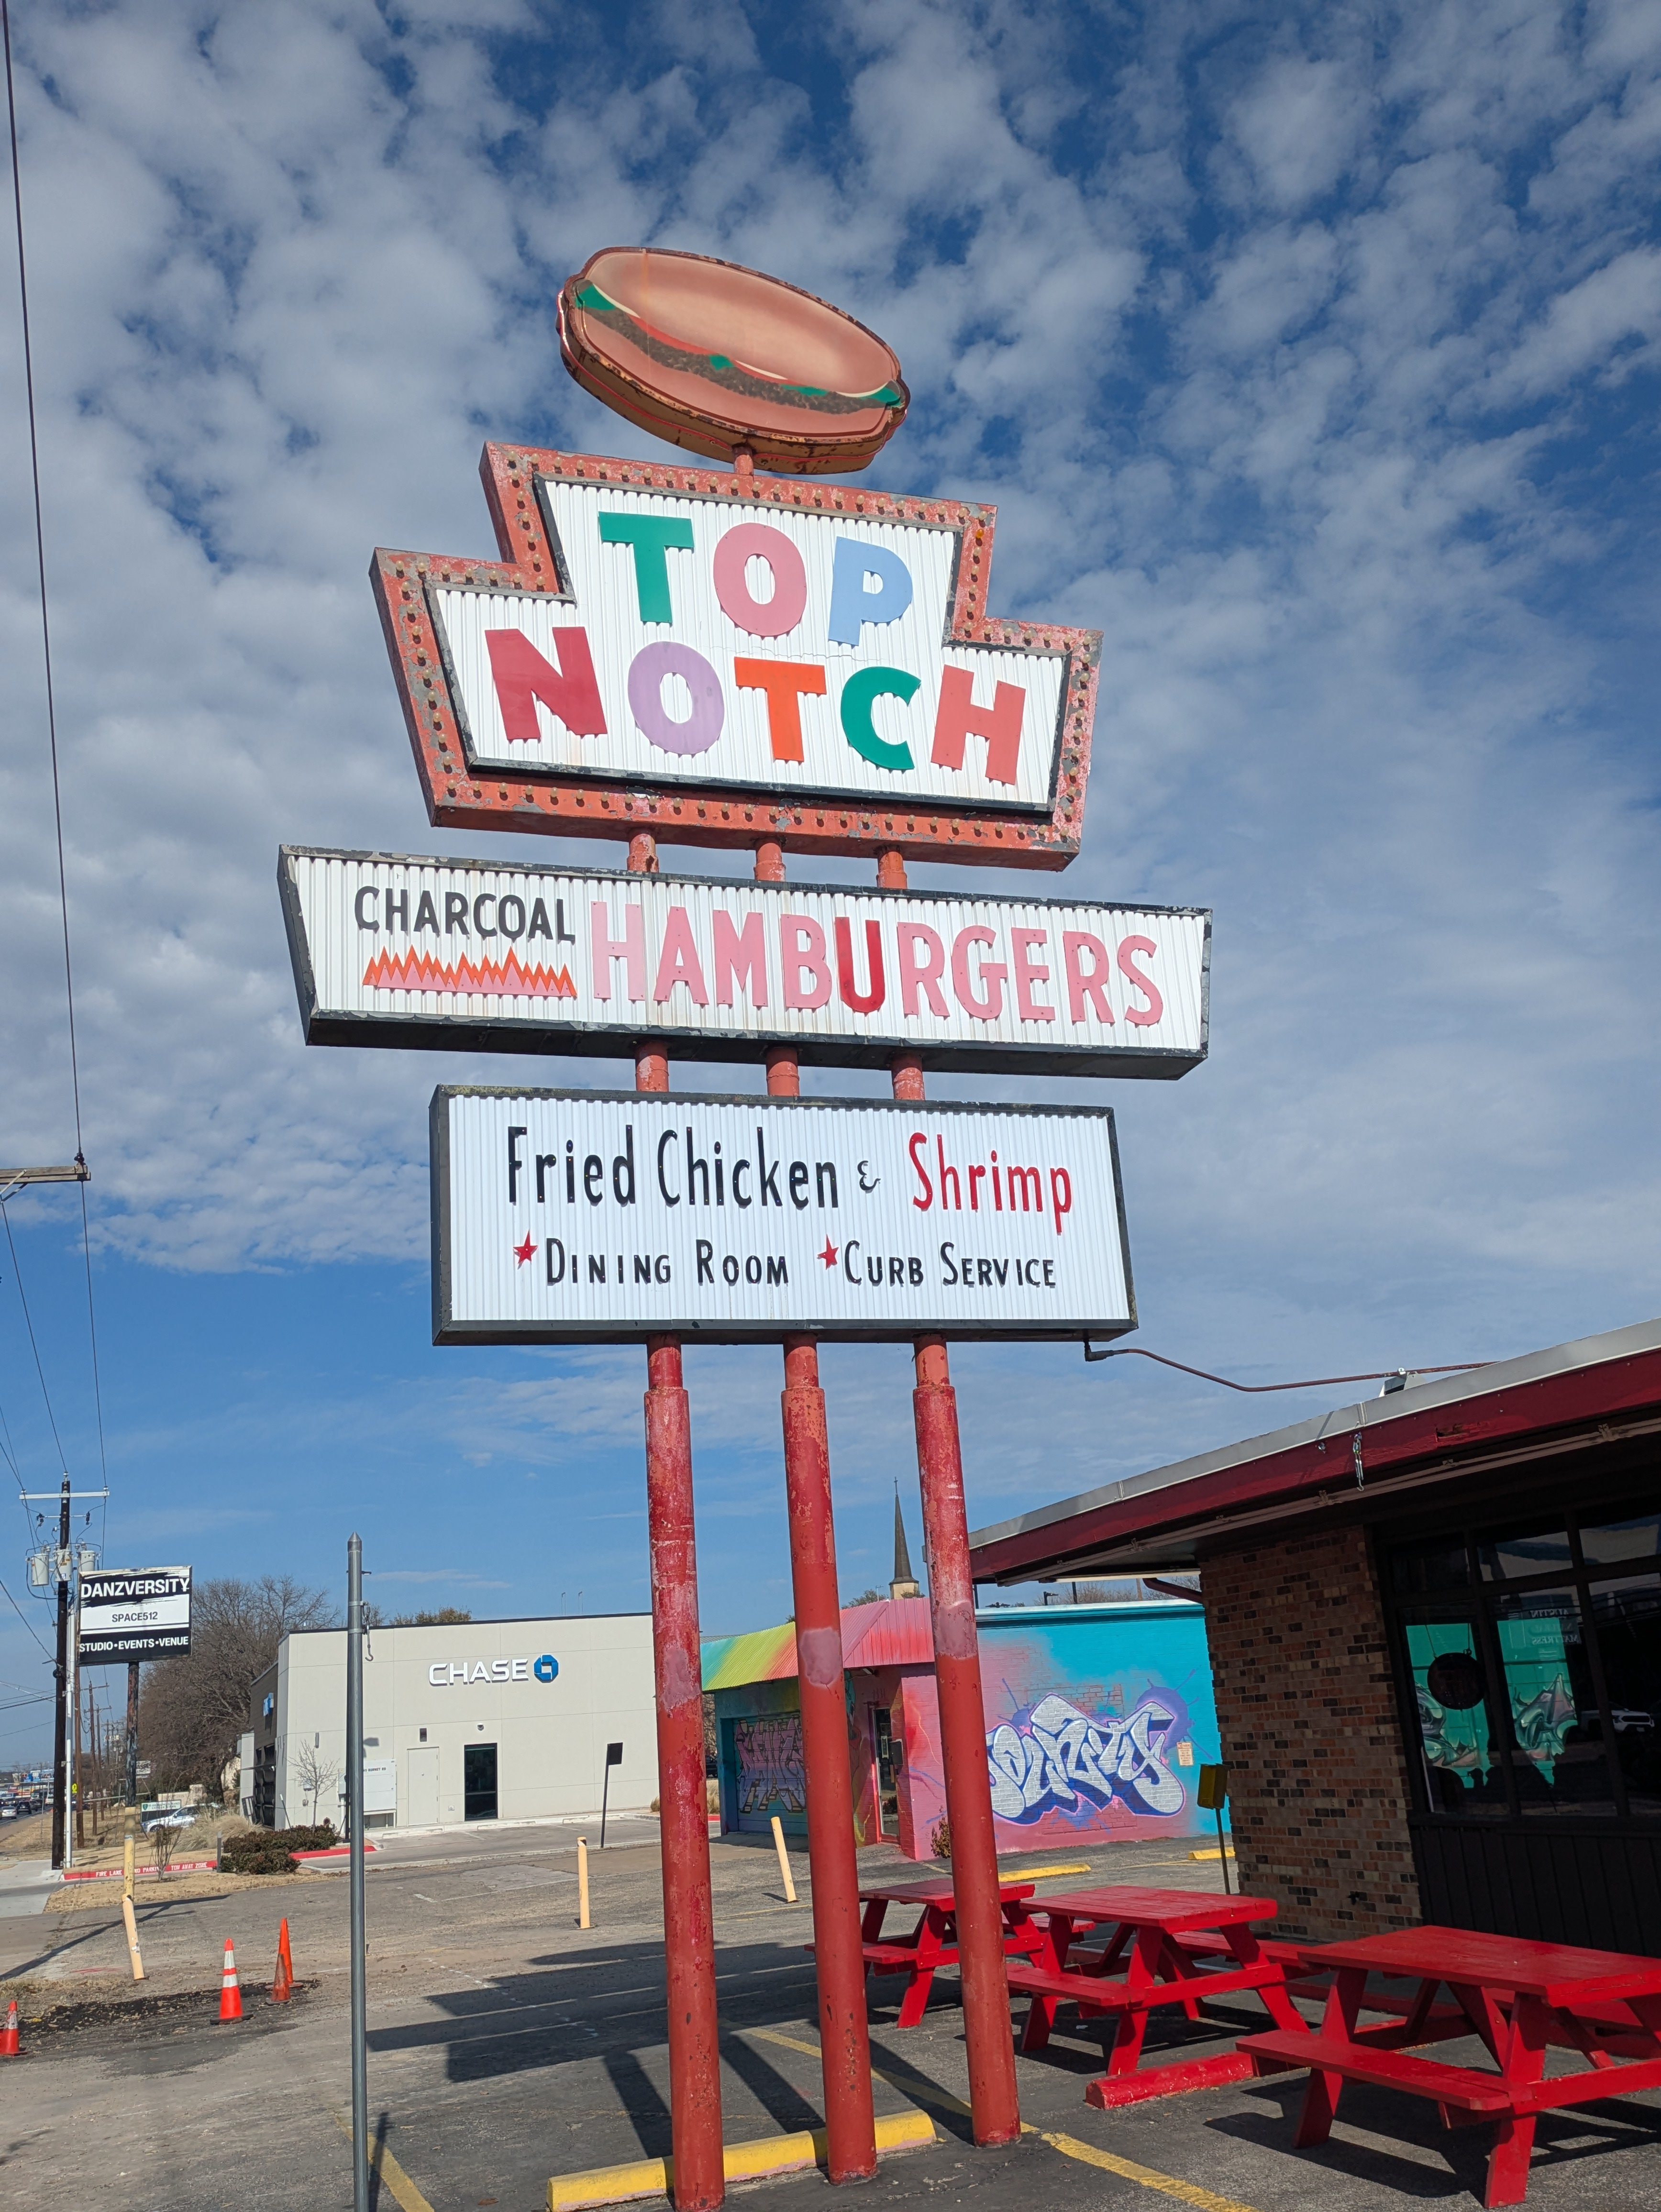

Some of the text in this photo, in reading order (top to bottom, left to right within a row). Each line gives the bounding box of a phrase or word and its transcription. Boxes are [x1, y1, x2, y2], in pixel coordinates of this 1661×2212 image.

[598, 510, 913, 646] TOP
[484, 626, 1026, 785] NOTCH
[354, 885, 1163, 1026] CHARCOAL HAMBURGERS
[508, 1124, 1072, 1235] Fried Chicken & Shrimp
[546, 1238, 1056, 1287] DINING ROOM CURB SERVICE
[81, 1578, 190, 1598] DANZVERSITY
[111, 1611, 158, 1623] SPACE512
[429, 1658, 529, 1686] CHASE
